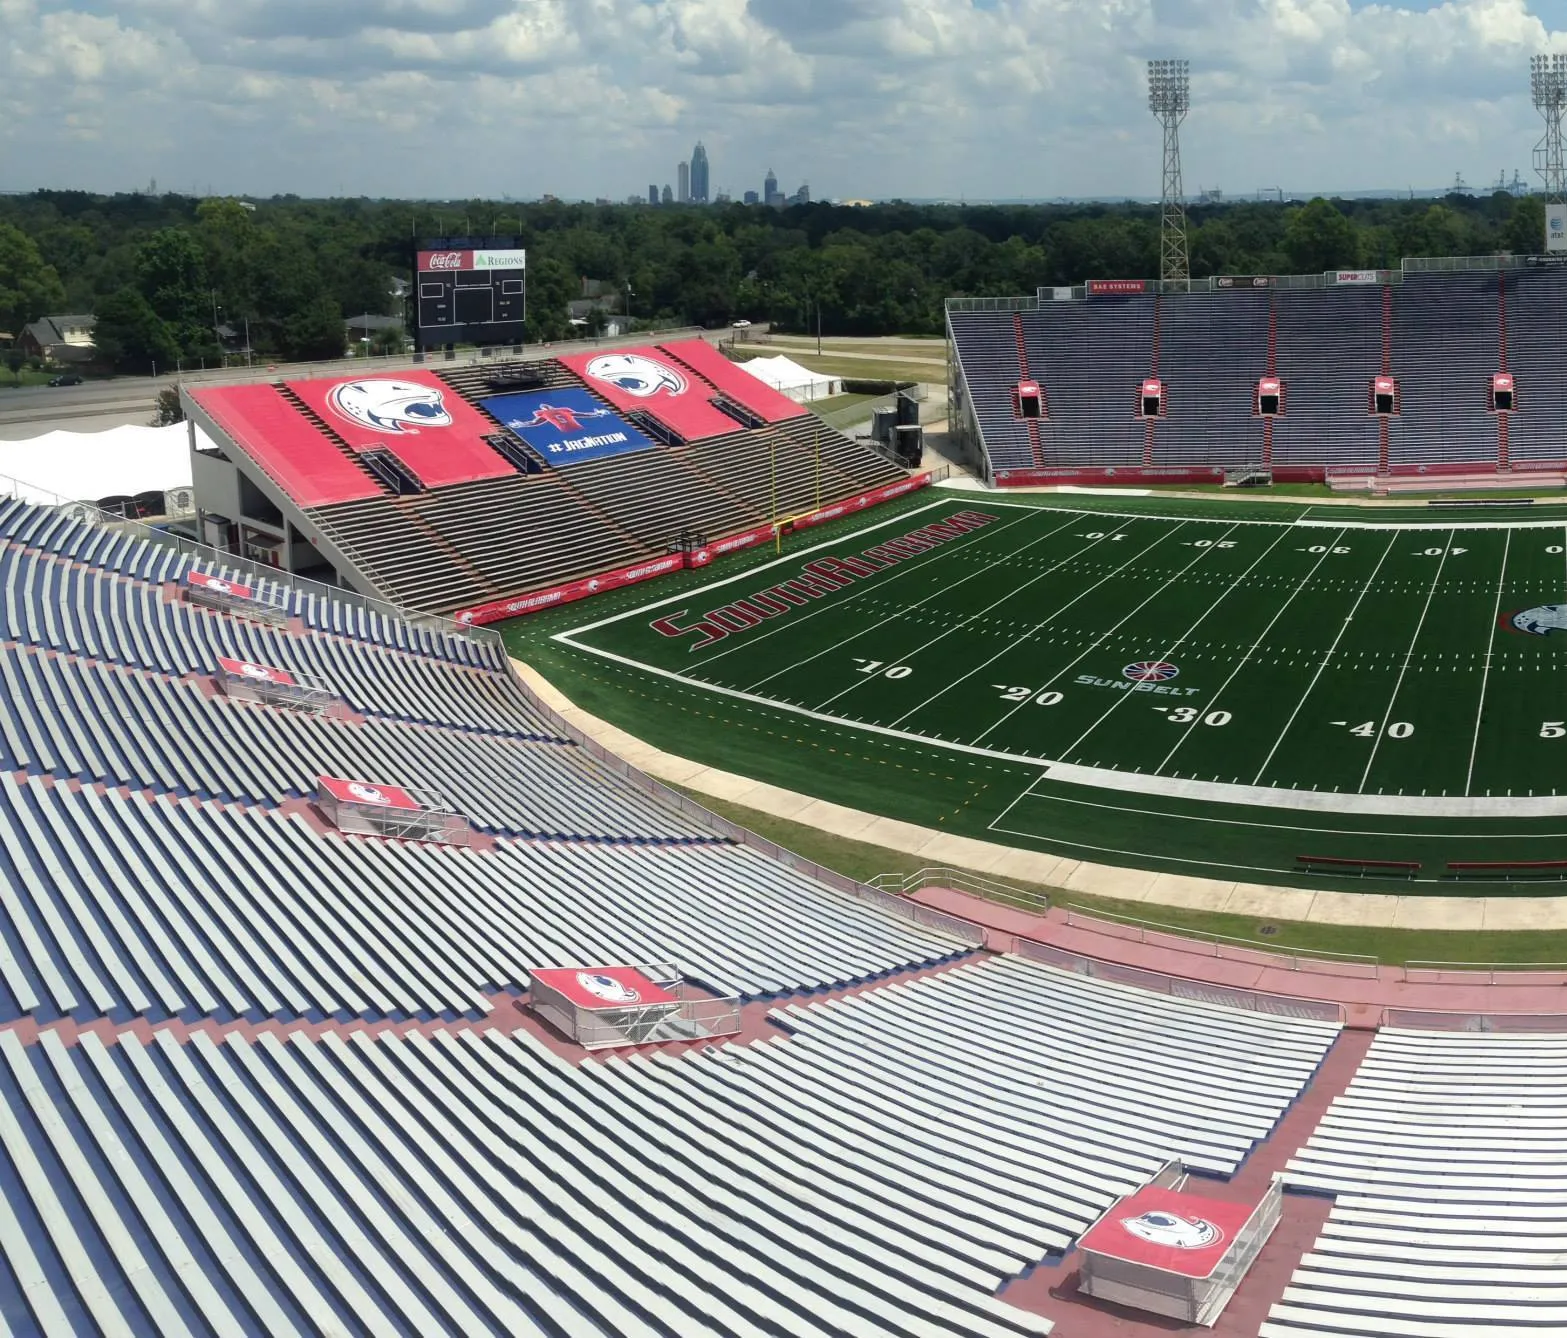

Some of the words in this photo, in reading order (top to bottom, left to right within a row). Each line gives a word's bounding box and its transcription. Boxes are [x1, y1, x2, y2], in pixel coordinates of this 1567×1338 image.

[488, 255, 523, 266] REGIONS
[1086, 532, 1128, 542] 10
[1193, 539, 1238, 549] 20
[1308, 544, 1352, 554] 30
[1424, 547, 1468, 556] 40
[856, 660, 912, 679] 10
[1074, 675, 1132, 690] SUN
[1135, 682, 1200, 696] BELT
[1000, 685, 1065, 706] 20
[1167, 707, 1232, 727] 30
[1349, 721, 1415, 739] 40
